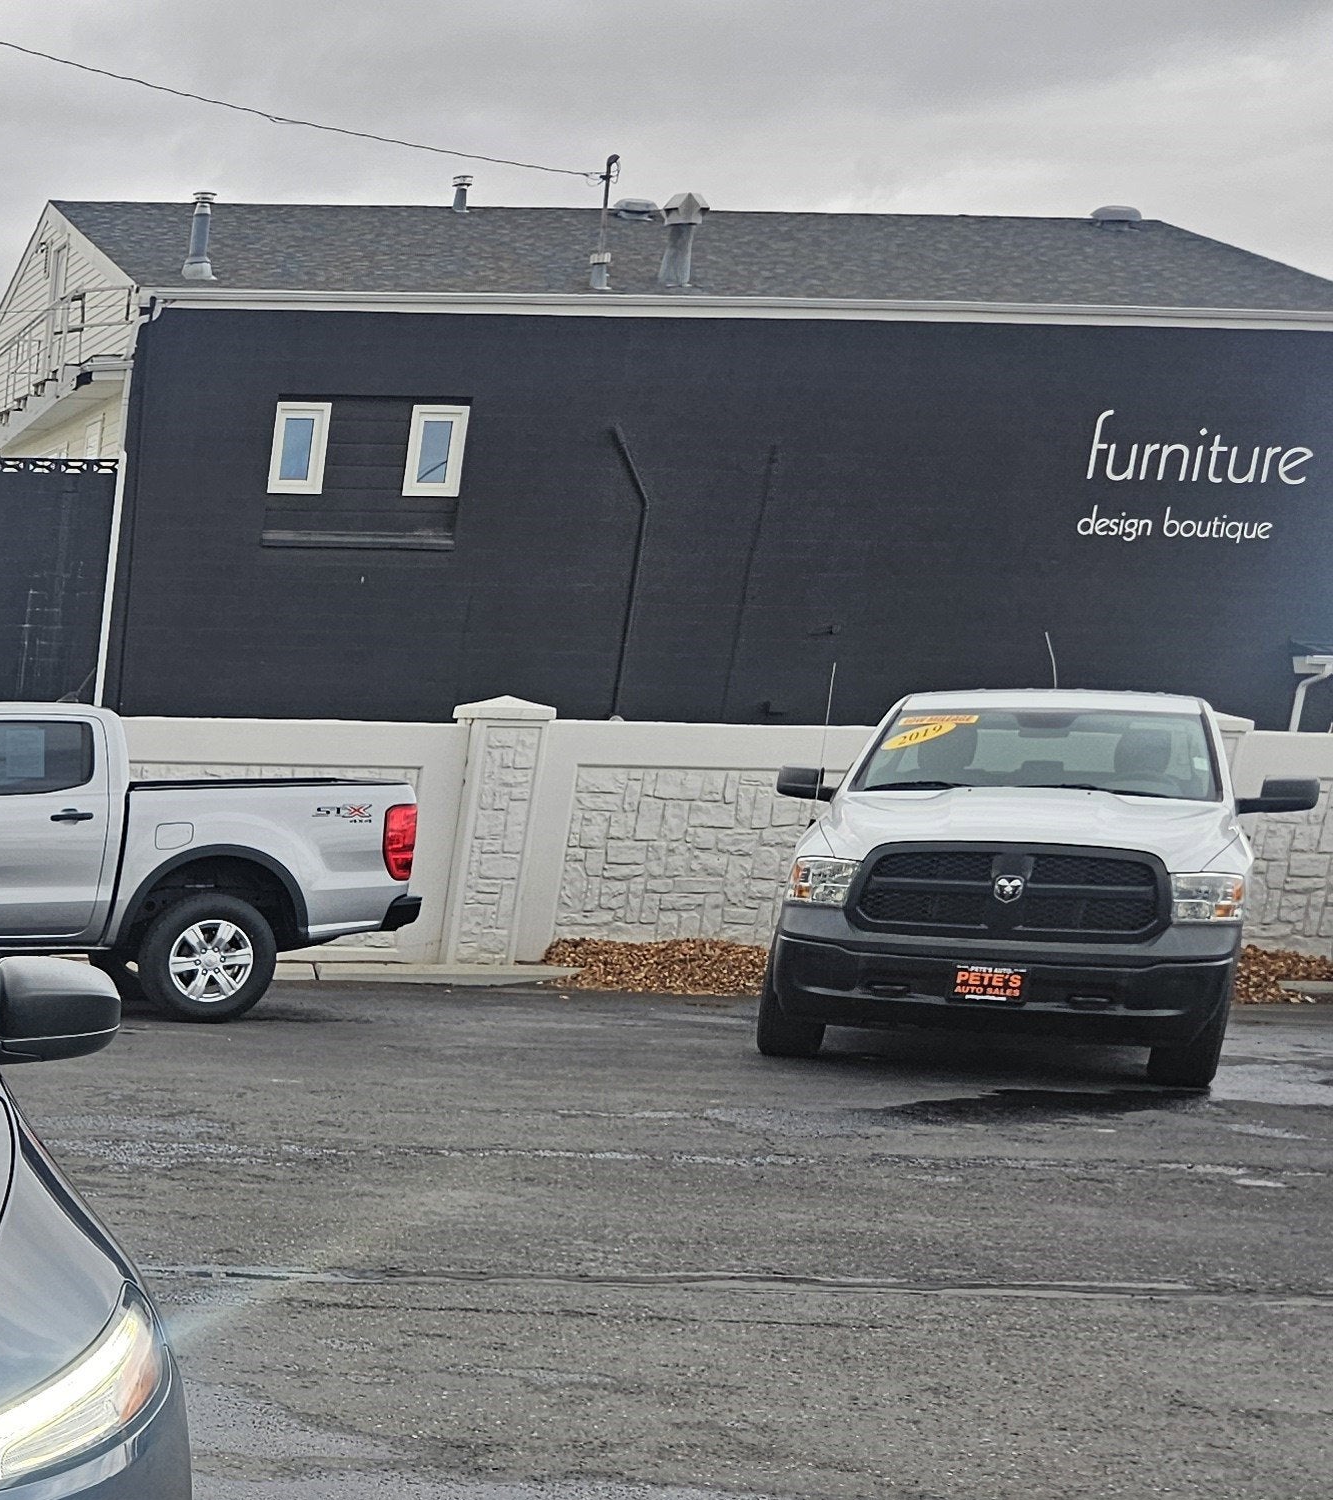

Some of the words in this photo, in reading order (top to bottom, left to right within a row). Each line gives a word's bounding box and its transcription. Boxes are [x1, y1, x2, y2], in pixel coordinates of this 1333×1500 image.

[1085, 409, 1314, 485] furniture
[1077, 504, 1153, 542] design
[1162, 506, 1273, 544] boutique
[898, 725, 943, 745] 2019
[956, 971, 1022, 987] PETE'S
[954, 985, 984, 994] AUTO
[985, 987, 1020, 996] SALES
